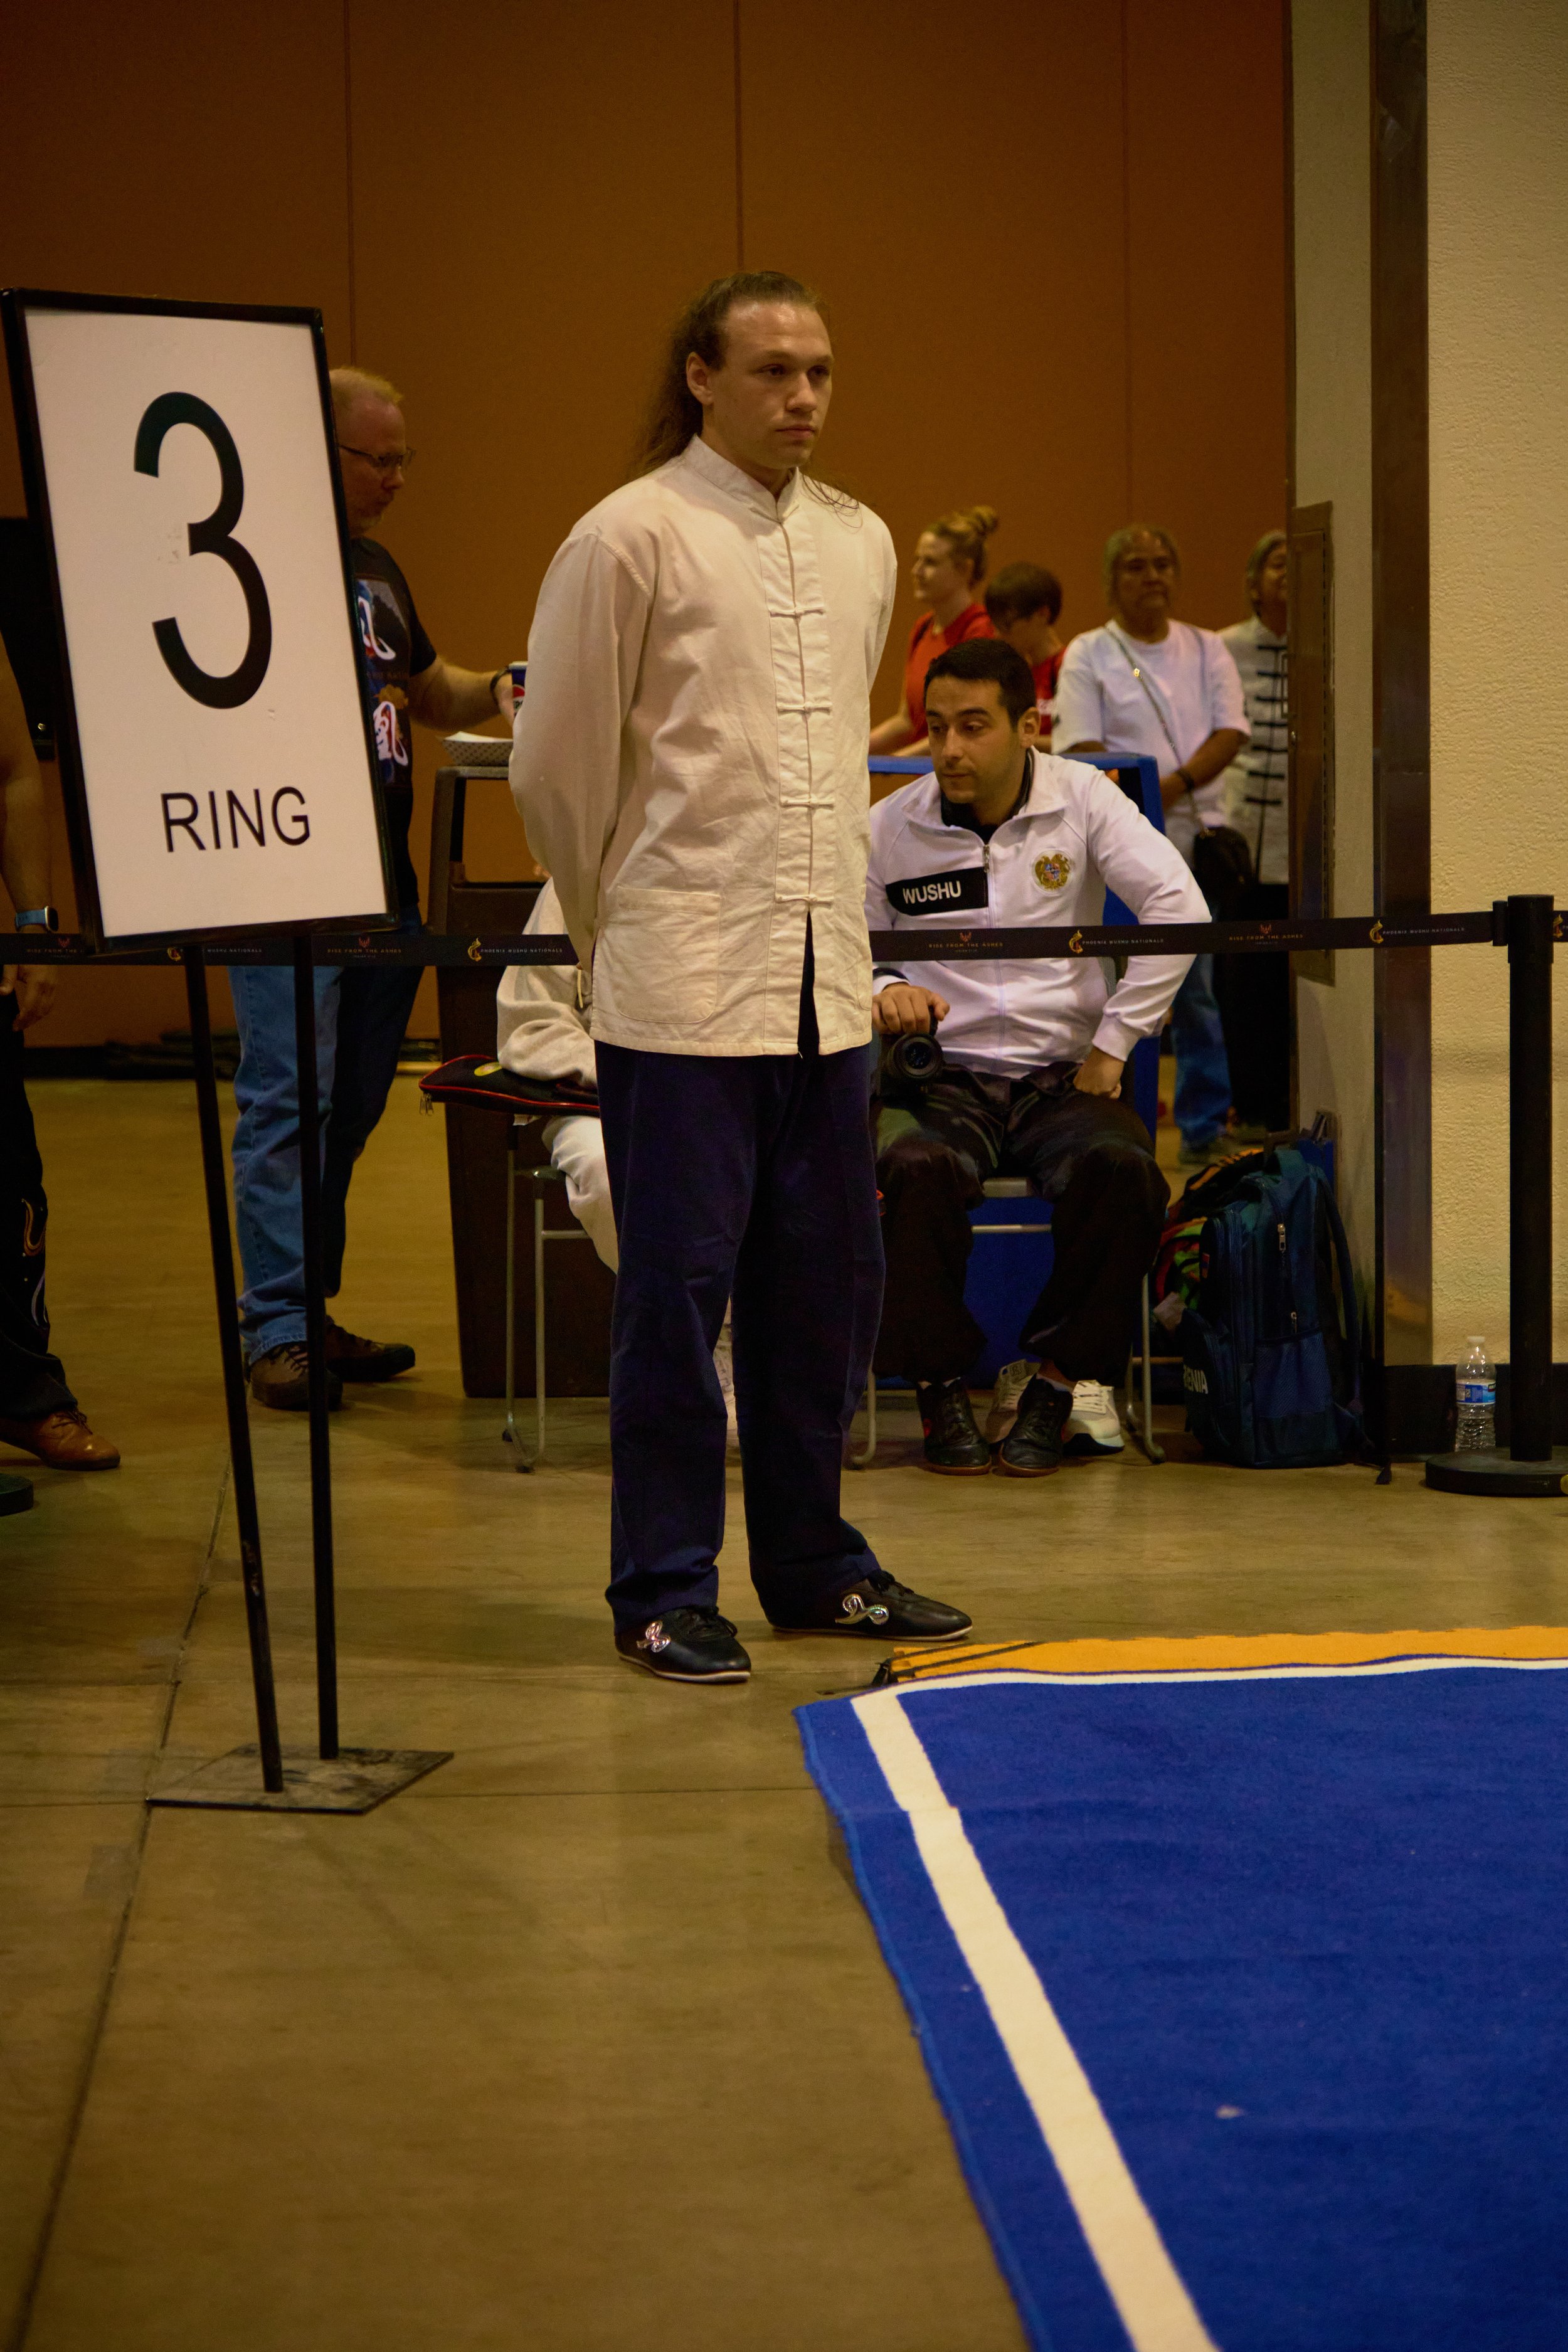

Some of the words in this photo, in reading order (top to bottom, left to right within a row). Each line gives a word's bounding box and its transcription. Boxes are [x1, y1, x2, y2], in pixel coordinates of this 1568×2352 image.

[134, 391, 272, 709] 3
[161, 787, 310, 853] RING
[903, 880, 962, 904] WUSHU
